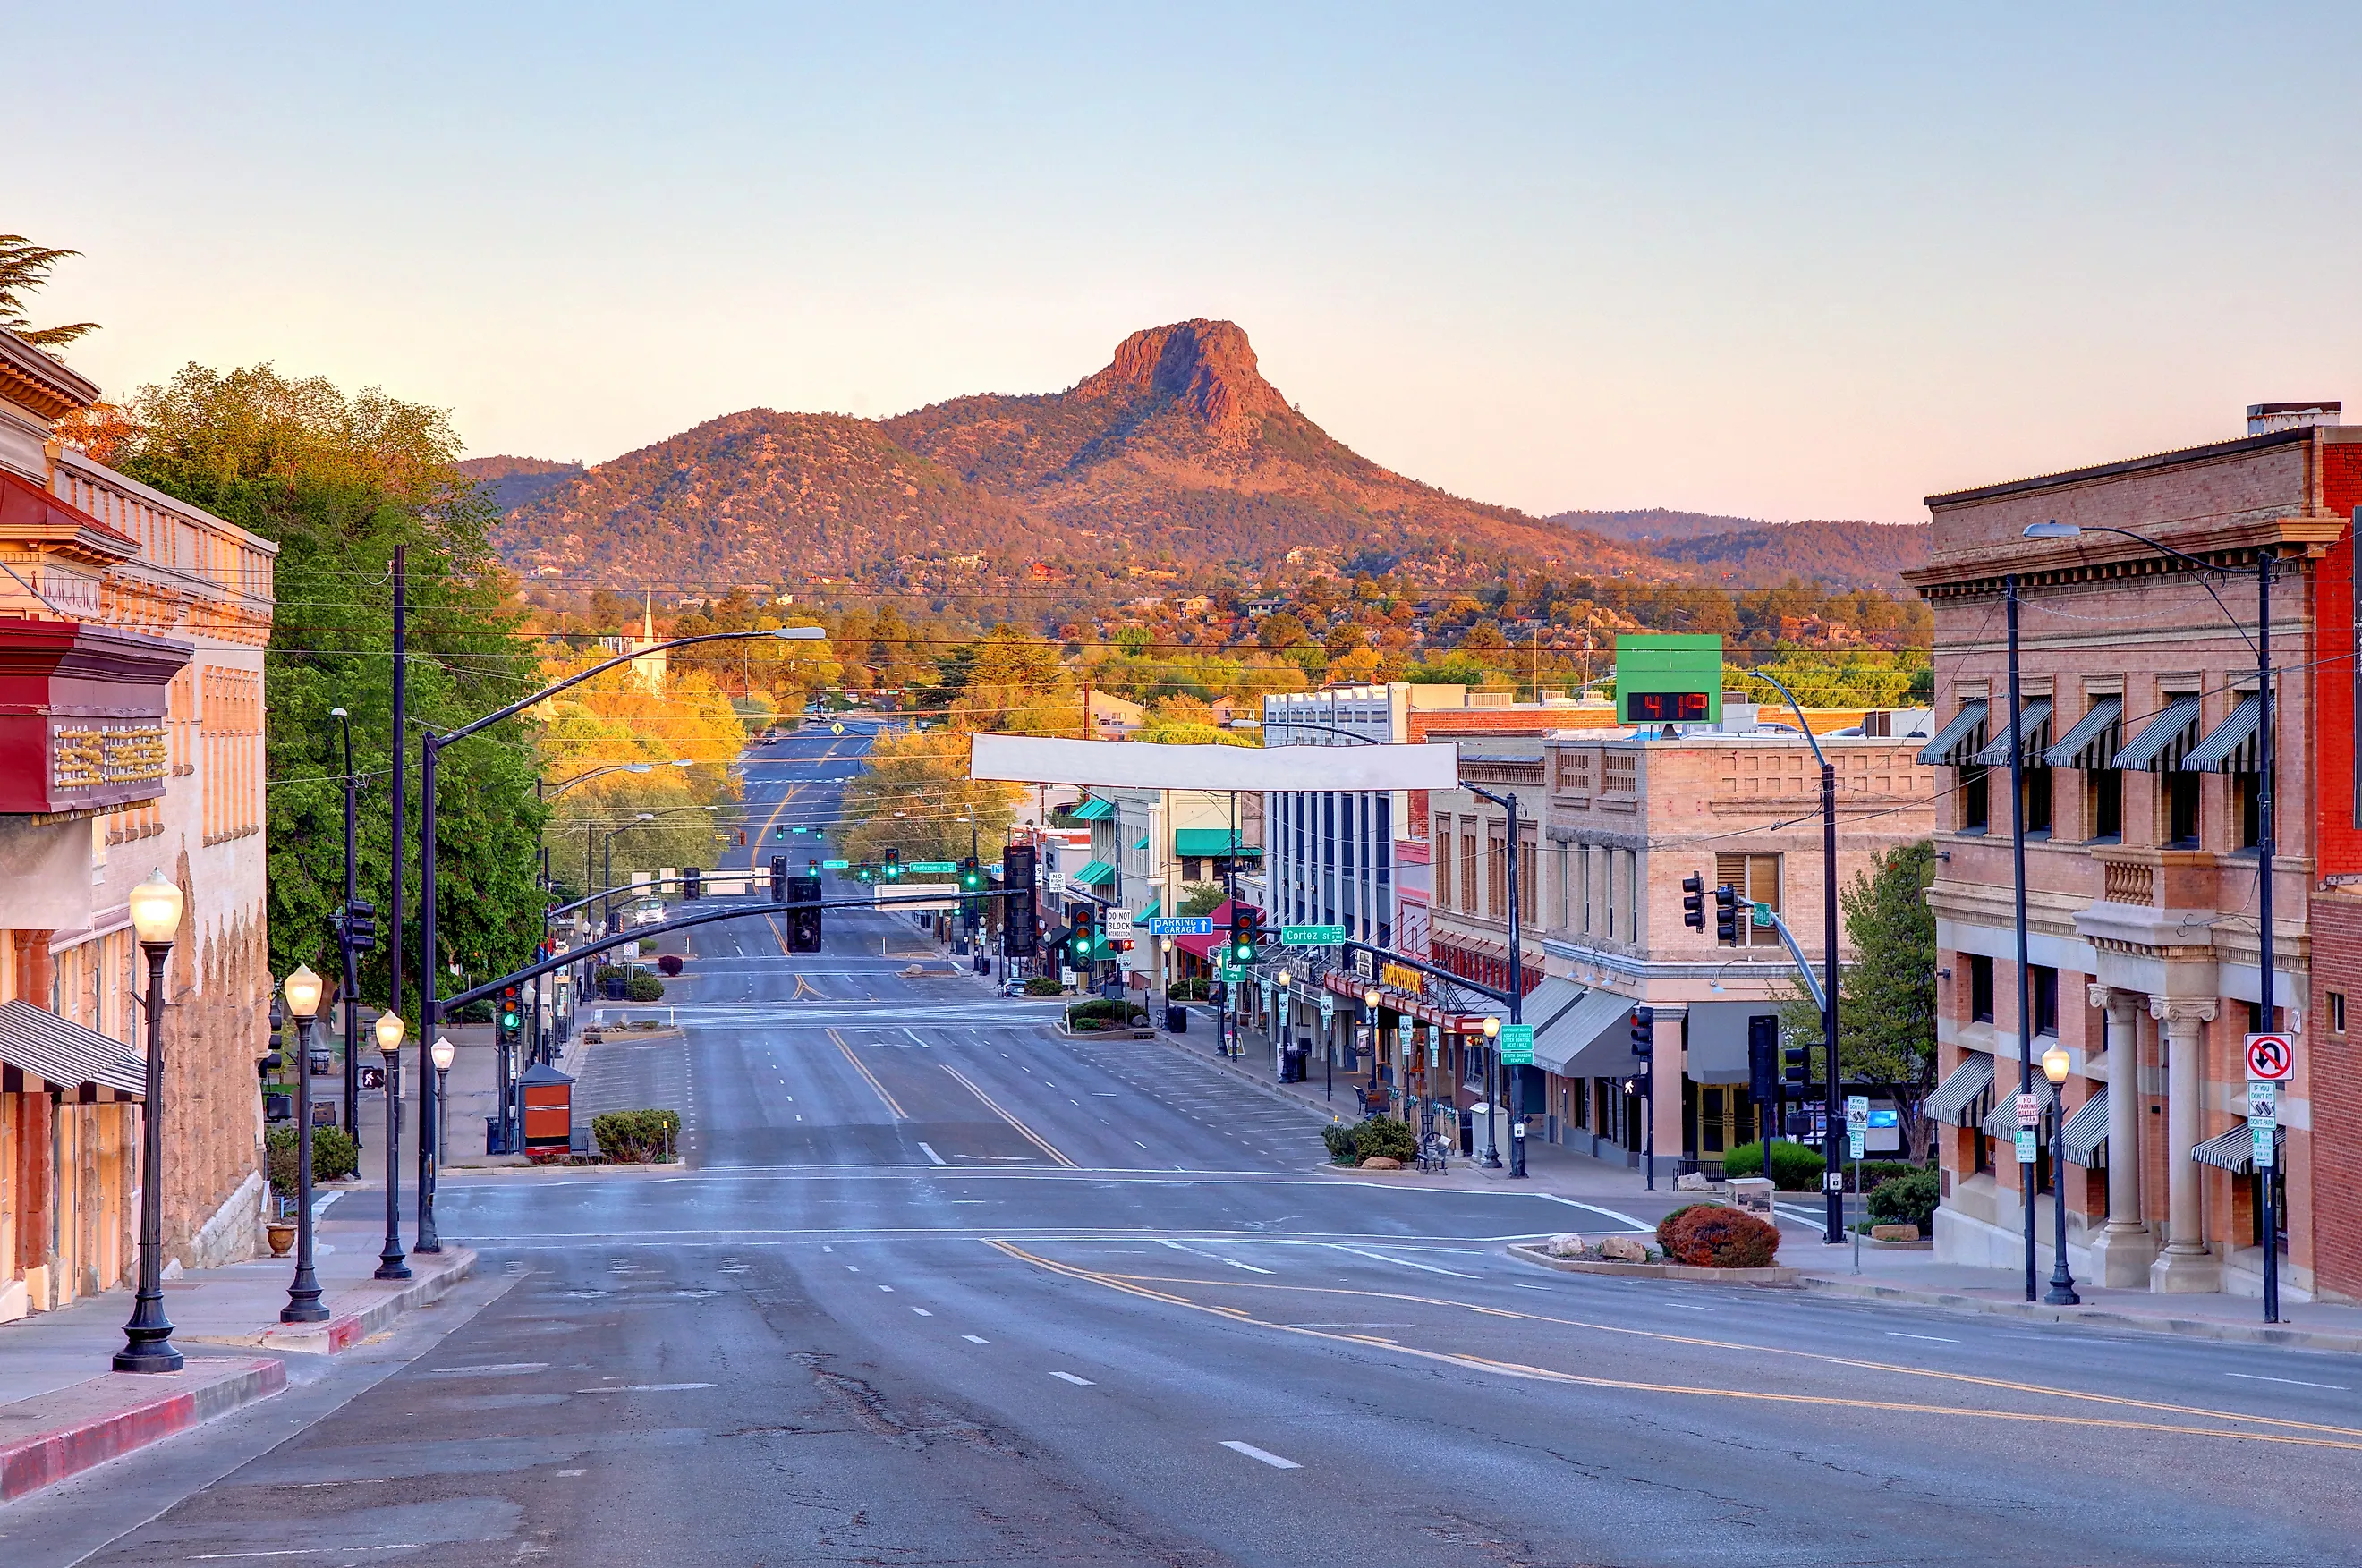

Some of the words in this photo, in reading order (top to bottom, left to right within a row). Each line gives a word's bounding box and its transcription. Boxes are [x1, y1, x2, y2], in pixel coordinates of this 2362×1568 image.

[1108, 911, 1117, 920] DO
[1118, 911, 1131, 920] NOT
[1108, 921, 1131, 930] BLOCK
[1154, 919, 1197, 934] PARKING
[1164, 926, 1197, 934] GARAGE
[1287, 930, 1318, 940] Cortez
[1322, 932, 1330, 940] St
